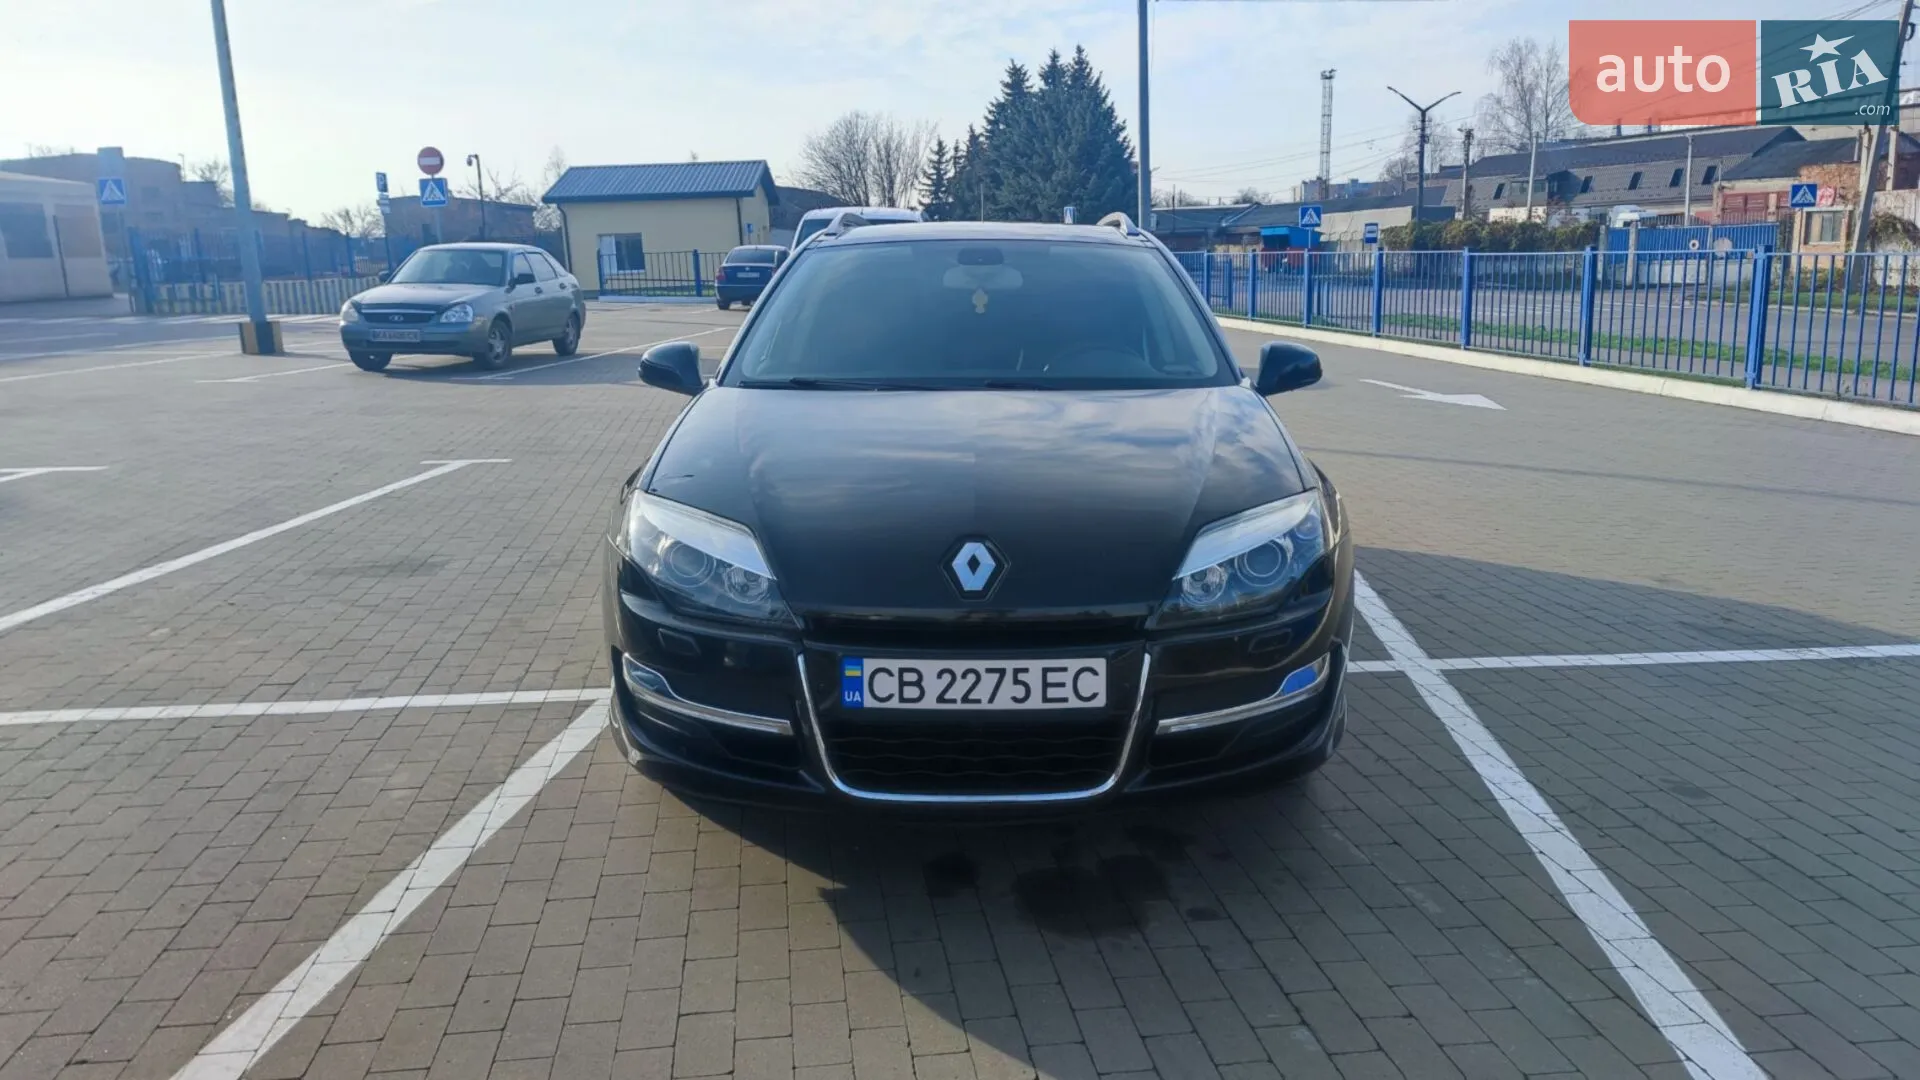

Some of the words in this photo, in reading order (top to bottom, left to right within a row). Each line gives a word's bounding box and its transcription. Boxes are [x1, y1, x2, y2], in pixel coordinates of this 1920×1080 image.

[845, 690, 861, 702] UA
[868, 667, 925, 703] CB
[936, 668, 1031, 704] 2275
[1041, 667, 1100, 703] EC
